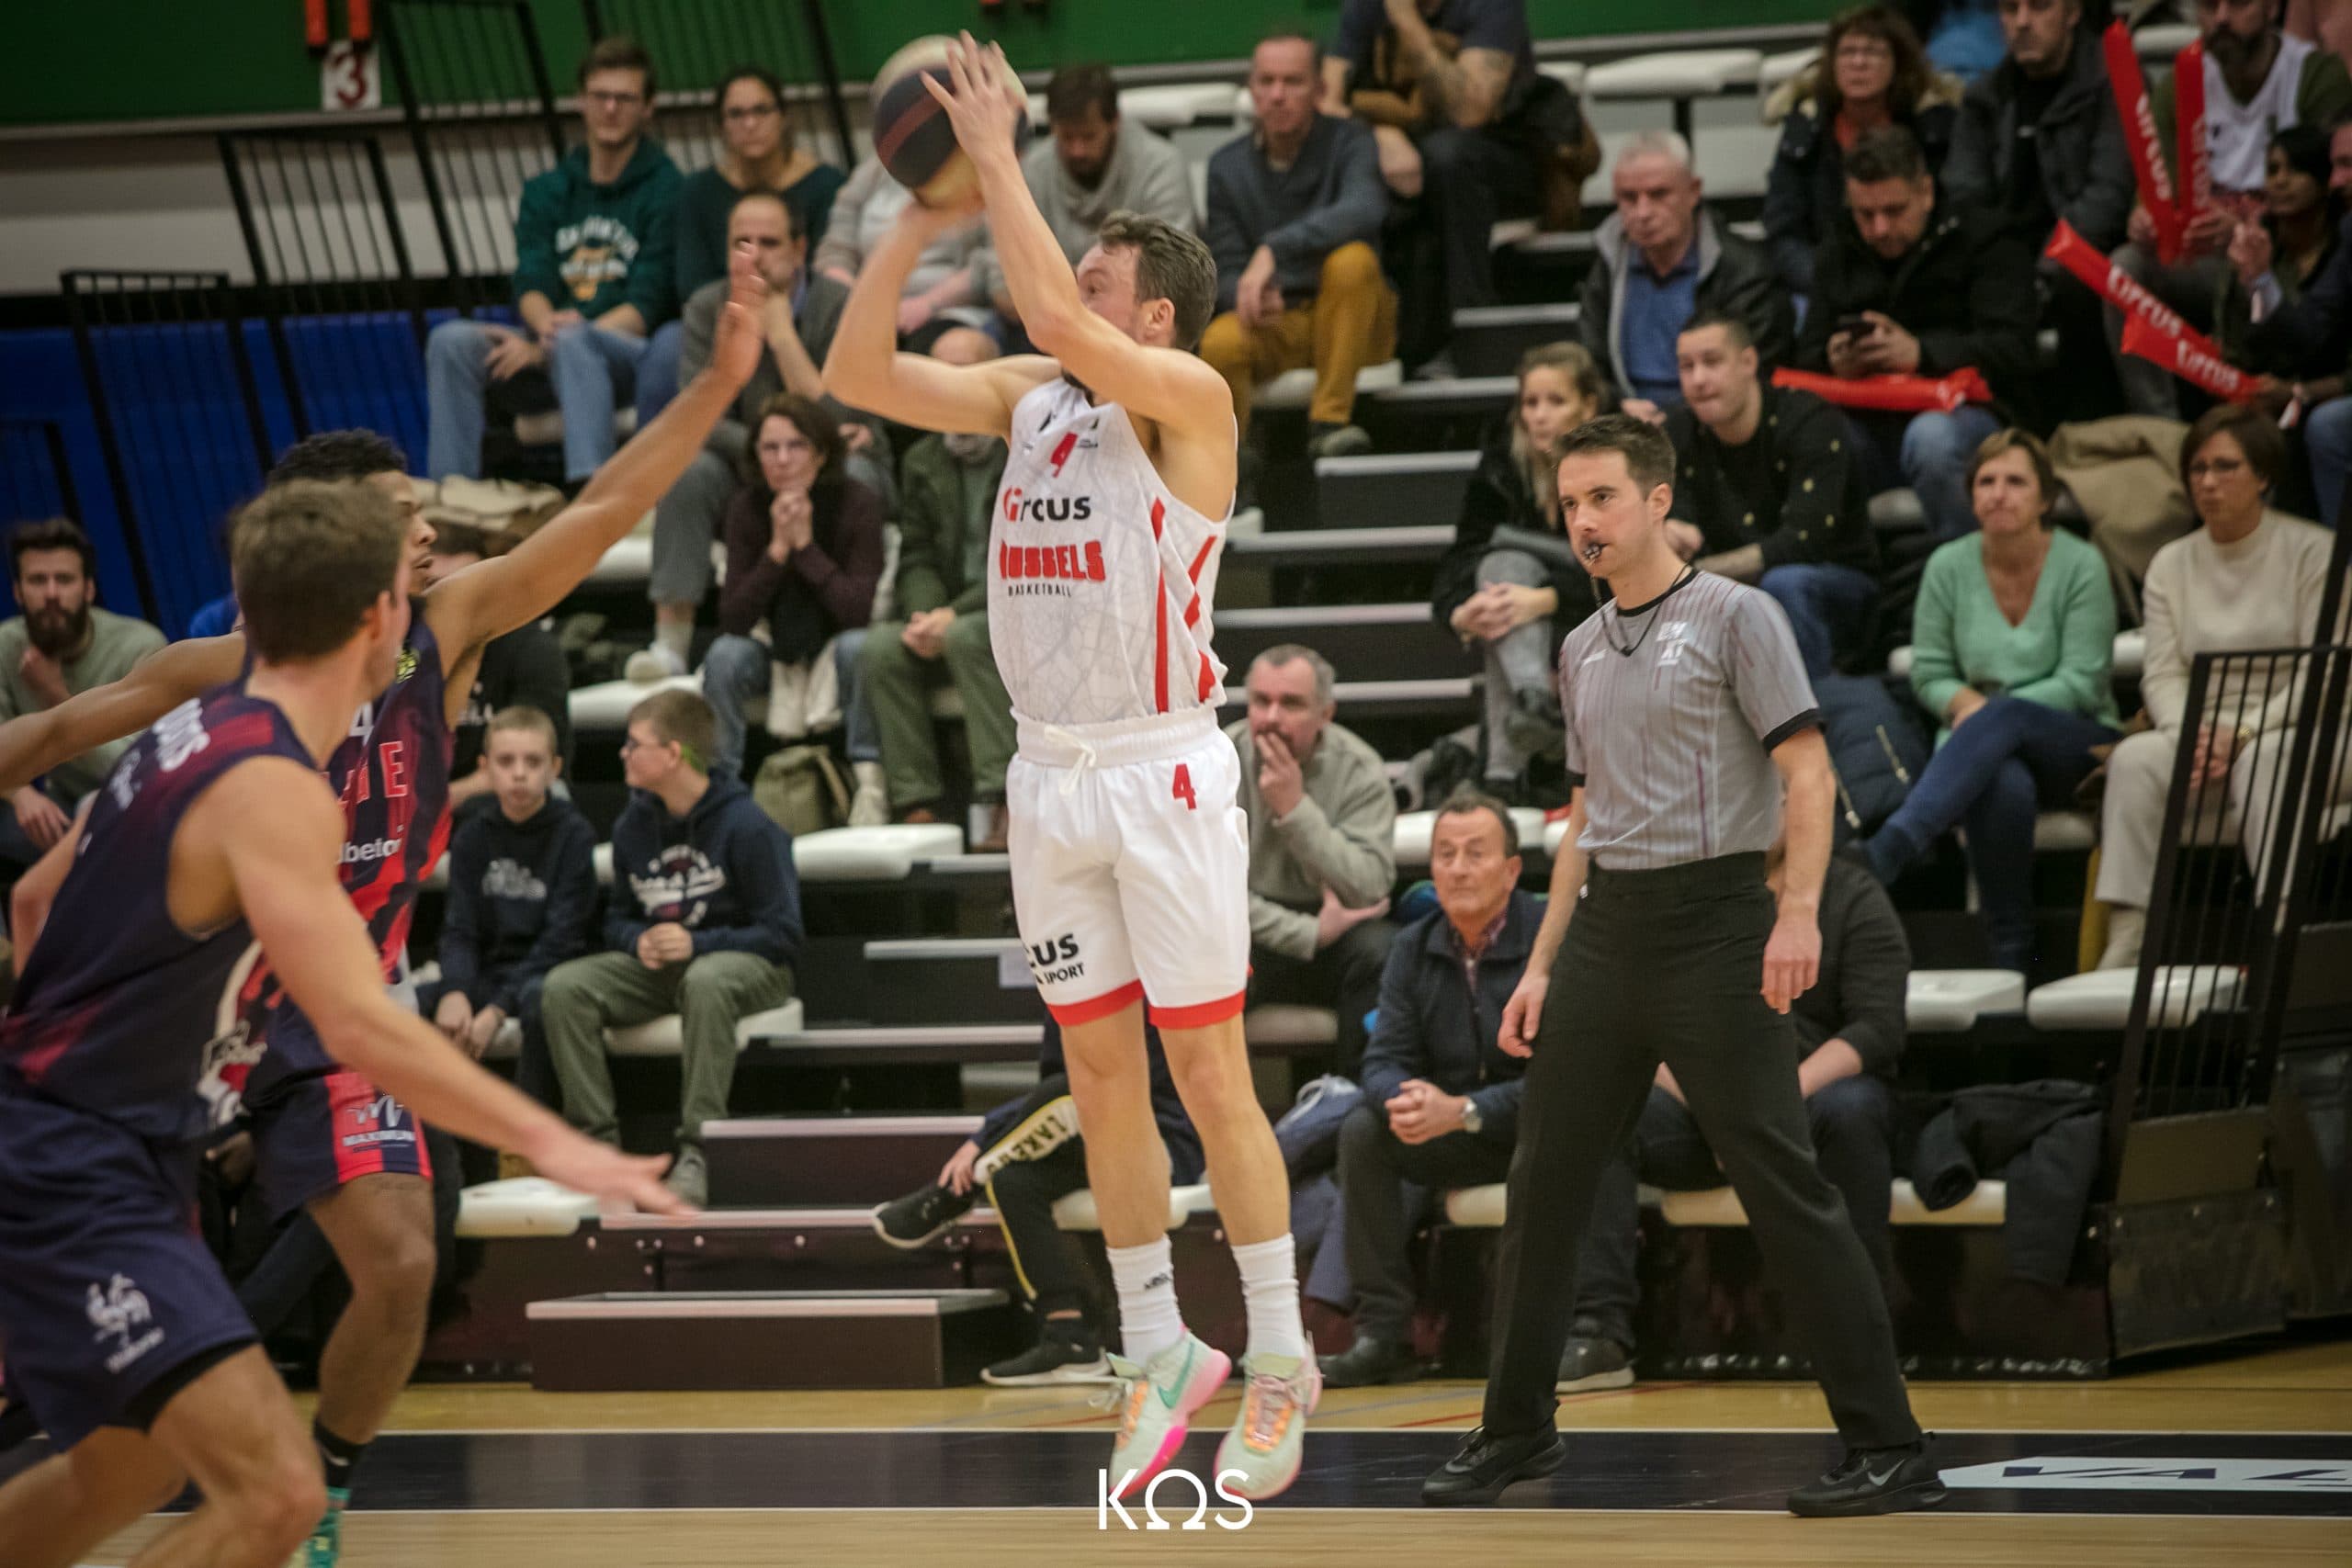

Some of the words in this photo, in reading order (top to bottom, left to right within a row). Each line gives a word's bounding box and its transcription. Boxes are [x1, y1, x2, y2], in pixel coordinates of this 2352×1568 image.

[332, 51, 368, 107] 3
[1008, 583, 1072, 598] BASKETBALL
[1172, 763, 1197, 810] 4
